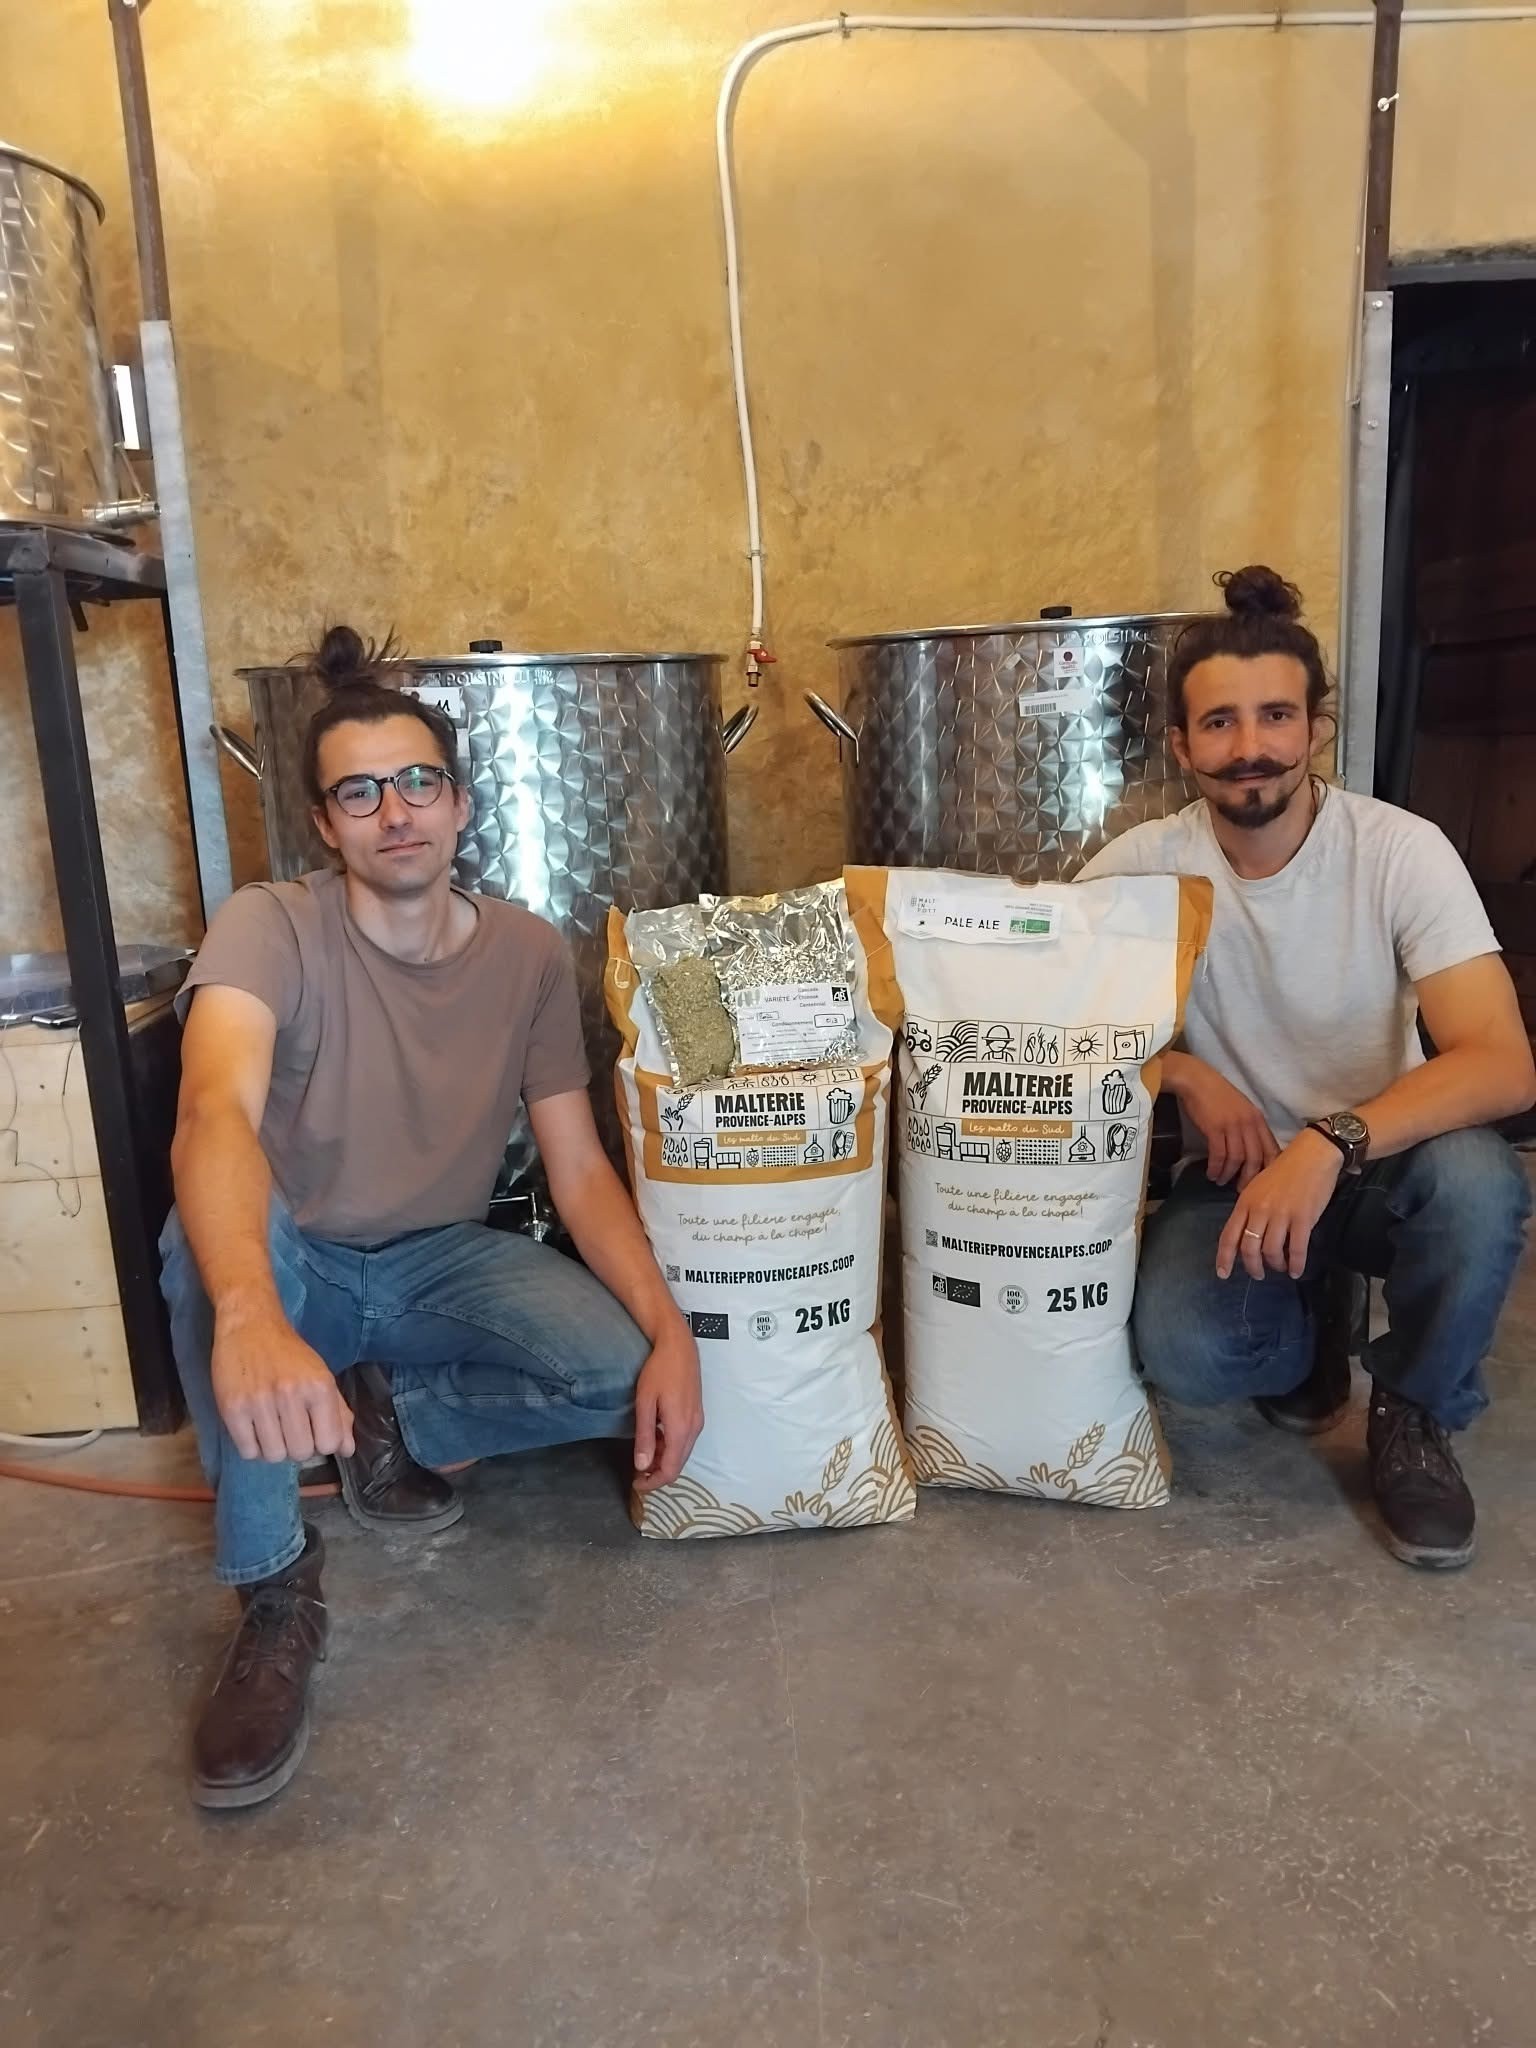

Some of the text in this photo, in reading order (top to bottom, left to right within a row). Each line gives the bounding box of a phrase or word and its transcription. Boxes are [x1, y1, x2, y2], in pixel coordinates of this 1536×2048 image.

[944, 917, 1000, 930] PALE ALE
[962, 1099, 1073, 1115] PROVENCE-ALPES
[715, 1113, 806, 1129] PROVENCE-ALPES
[969, 1121, 1065, 1134] Les malts du Sud
[723, 1132, 801, 1145] Les malts du Sud
[936, 1183, 963, 1196] Toute
[967, 1190, 990, 1199] une
[948, 1201, 965, 1211] du
[967, 1204, 1007, 1220] champ
[1009, 1206, 1019, 1216] à
[1022, 1206, 1036, 1217] la
[678, 1213, 708, 1226] Toute
[713, 1217, 737, 1226] une
[692, 1231, 711, 1242] du
[713, 1231, 755, 1246] champ
[757, 1230, 767, 1240] à
[770, 1228, 785, 1240] la
[1047, 1282, 1108, 1313] 25 KG
[795, 1298, 851, 1333] 25 KG
